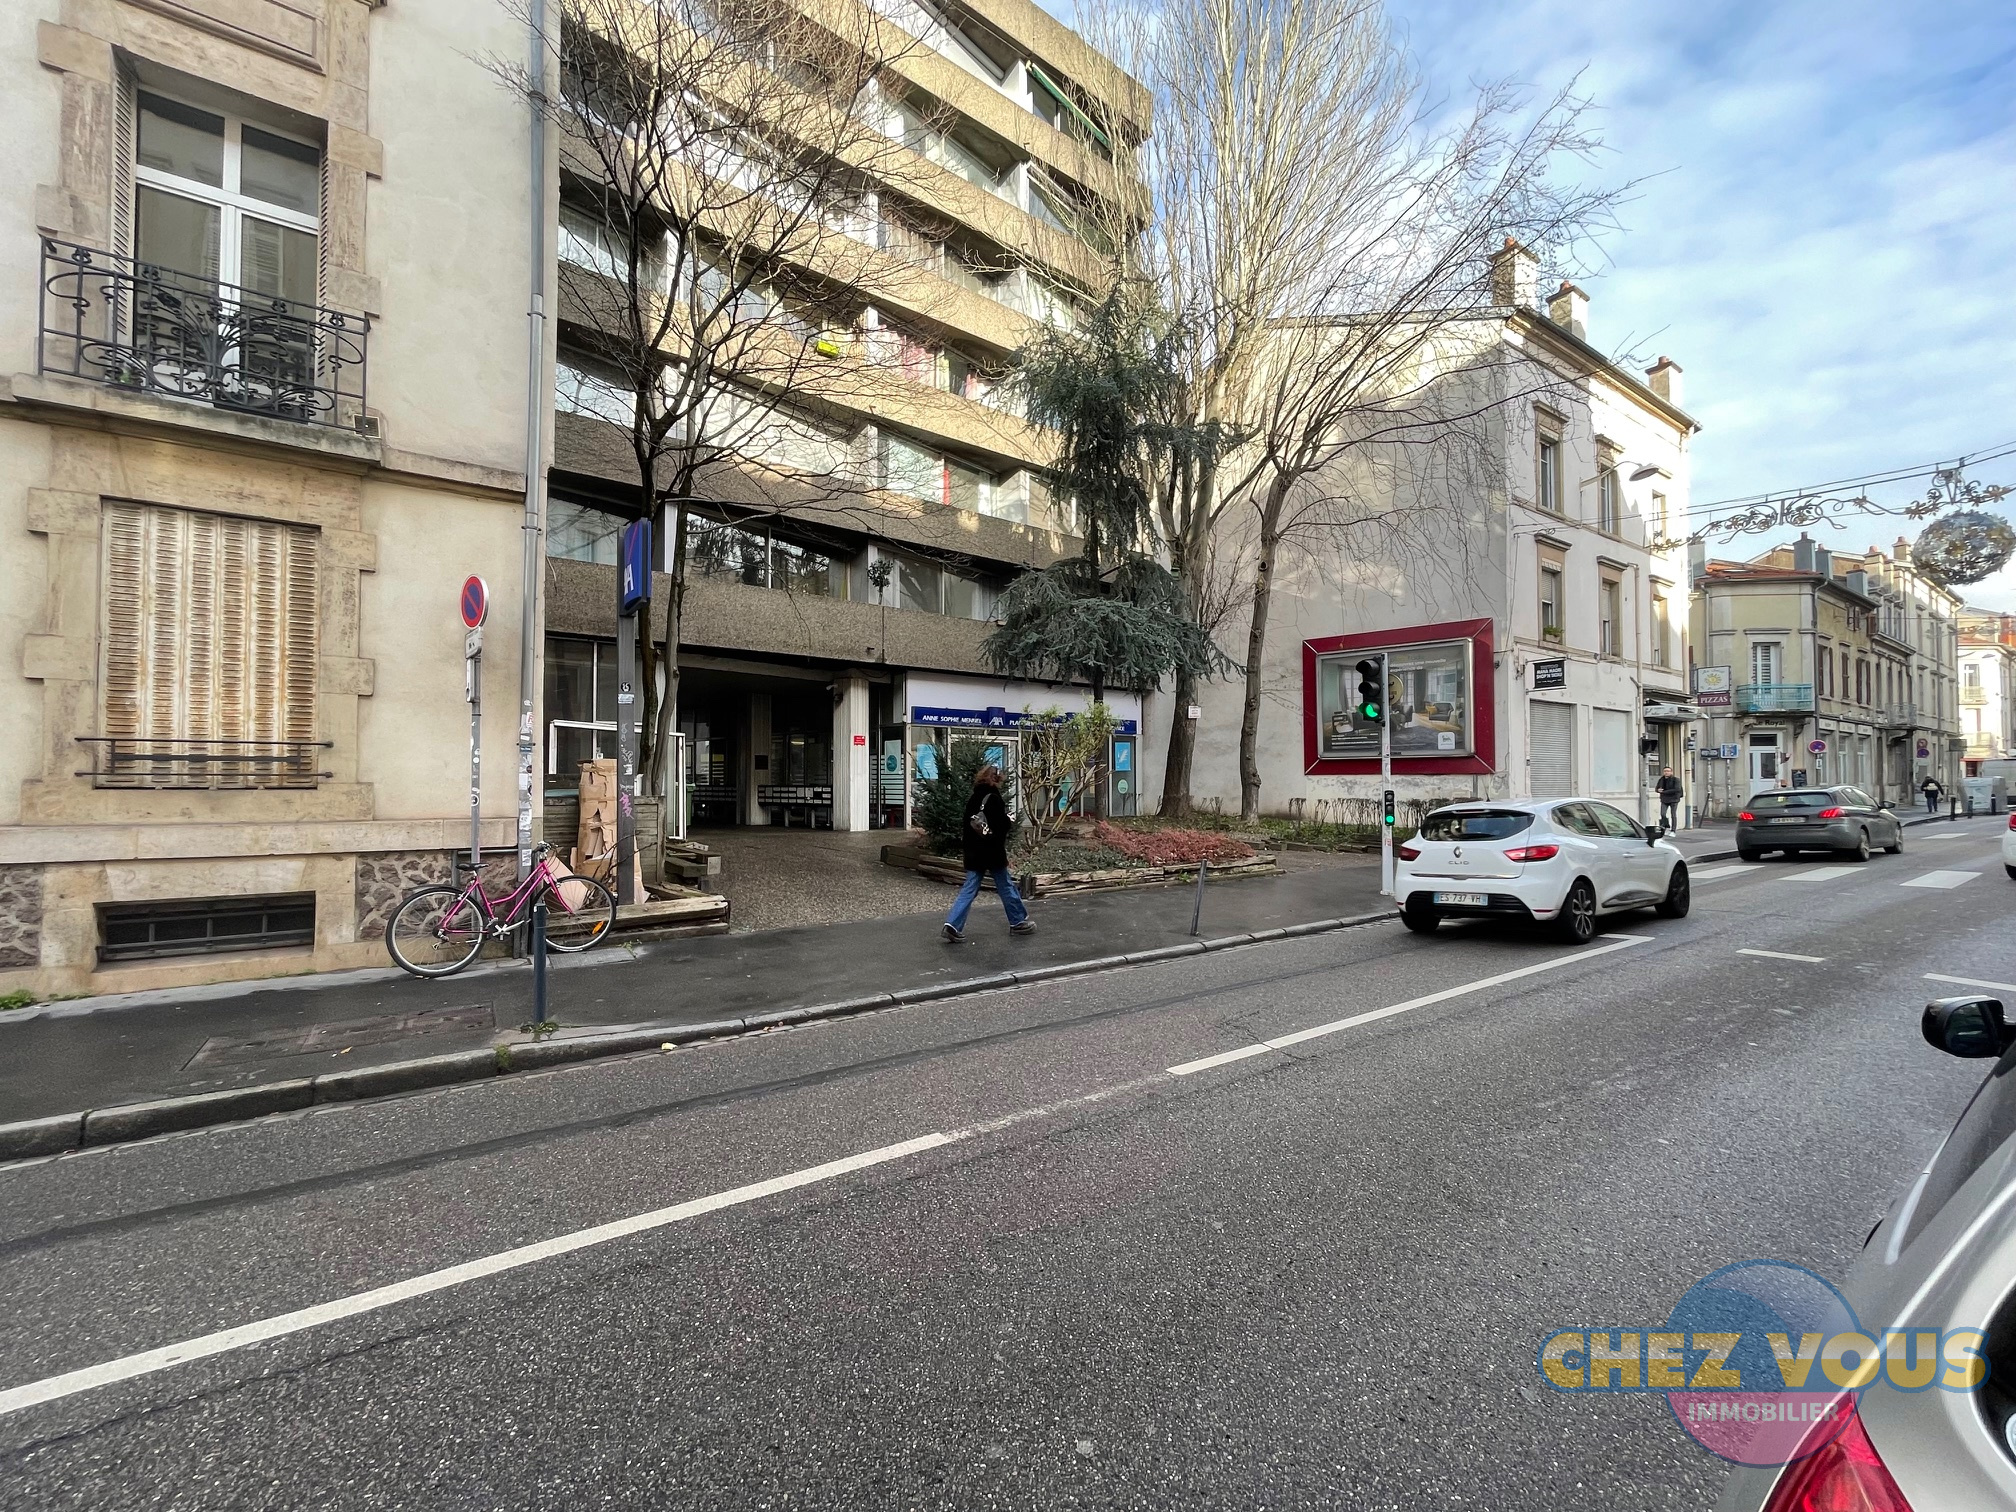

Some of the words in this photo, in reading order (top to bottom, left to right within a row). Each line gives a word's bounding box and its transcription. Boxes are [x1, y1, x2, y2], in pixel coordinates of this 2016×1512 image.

[1700, 696, 1728, 704] PIZZAS
[989, 716, 1004, 726] AXA
[1764, 719, 1786, 728] Royal
[1440, 893, 1481, 903] ES-737-VH
